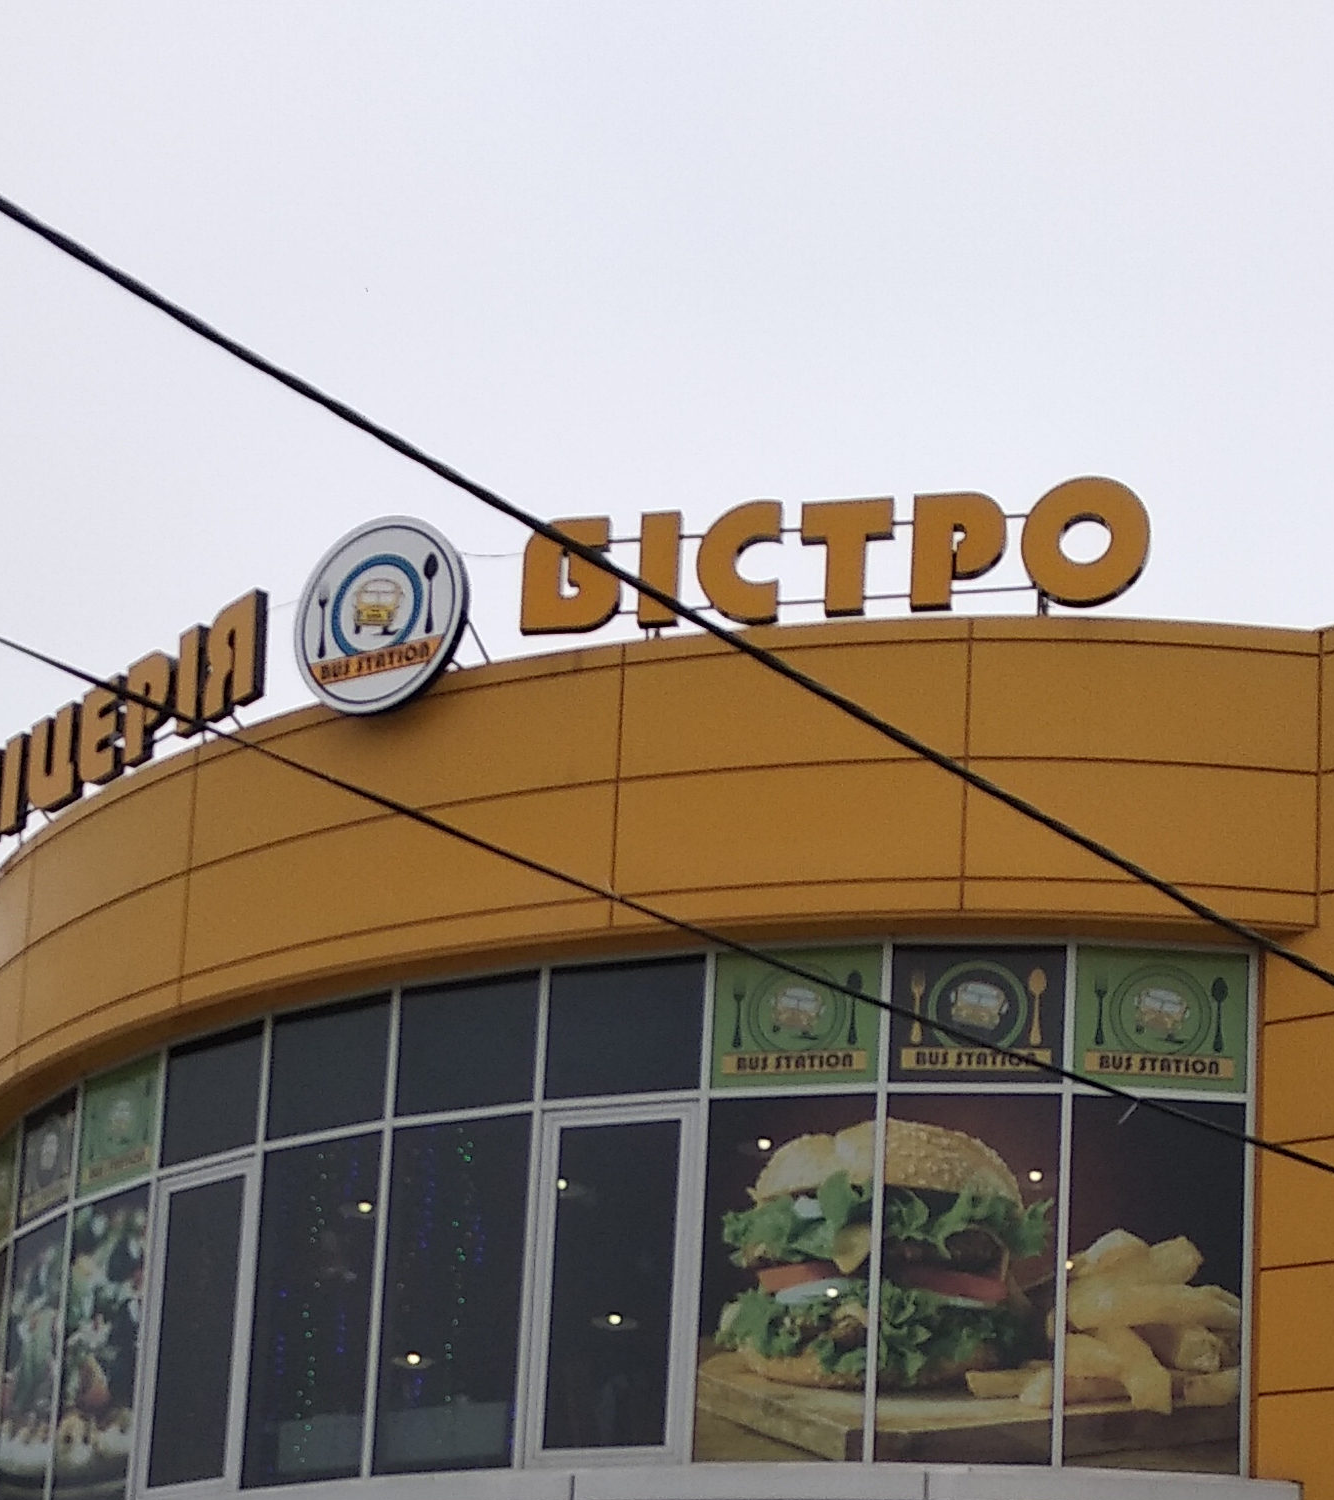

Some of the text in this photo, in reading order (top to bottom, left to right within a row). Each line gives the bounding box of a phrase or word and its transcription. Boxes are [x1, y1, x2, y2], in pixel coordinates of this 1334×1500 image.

[519, 475, 1151, 636] БІСТРО
[320, 641, 430, 680] BUS STATION
[736, 1052, 854, 1071] BUS STATION
[915, 1051, 949, 1066] BUS
[1099, 1055, 1220, 1075] BUS STATION
